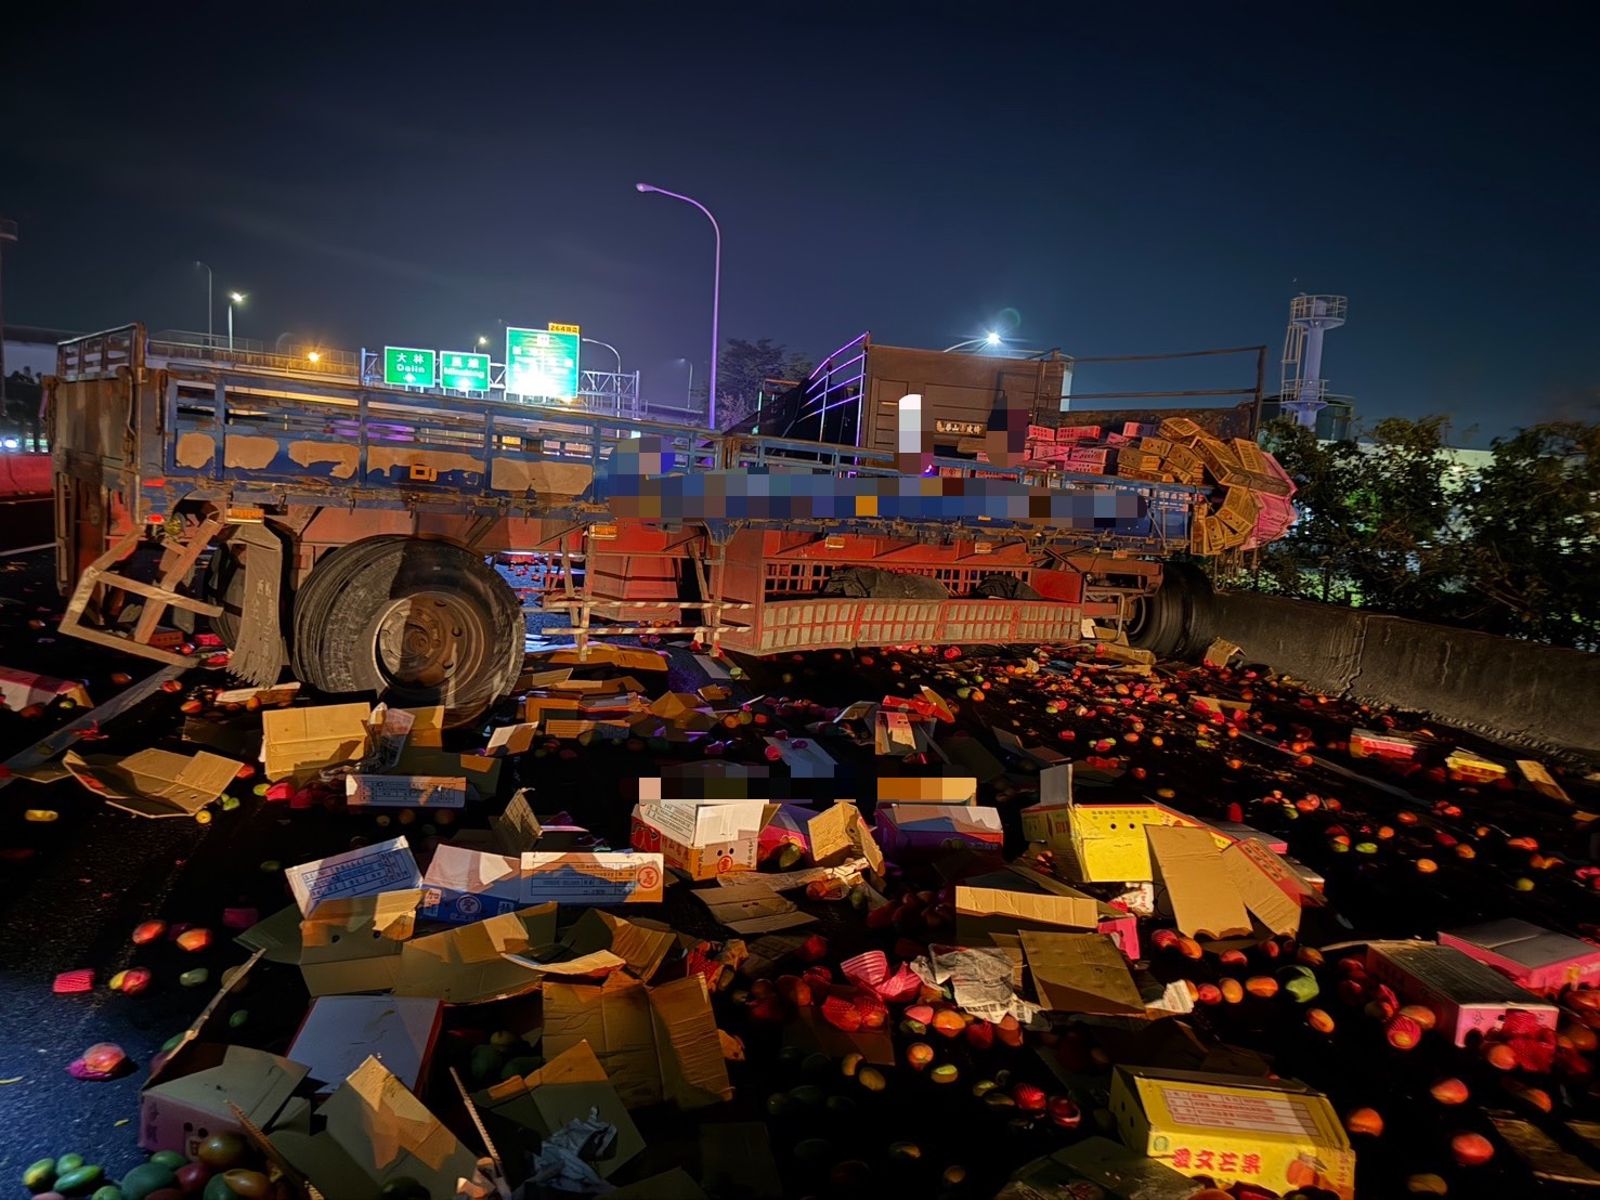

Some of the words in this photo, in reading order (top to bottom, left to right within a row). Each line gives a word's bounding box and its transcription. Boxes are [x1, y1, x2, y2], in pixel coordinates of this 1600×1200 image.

[396, 353, 424, 364] 大林
[396, 363, 425, 373] Dalin
[1173, 1148, 1261, 1174] 愛文芒果
